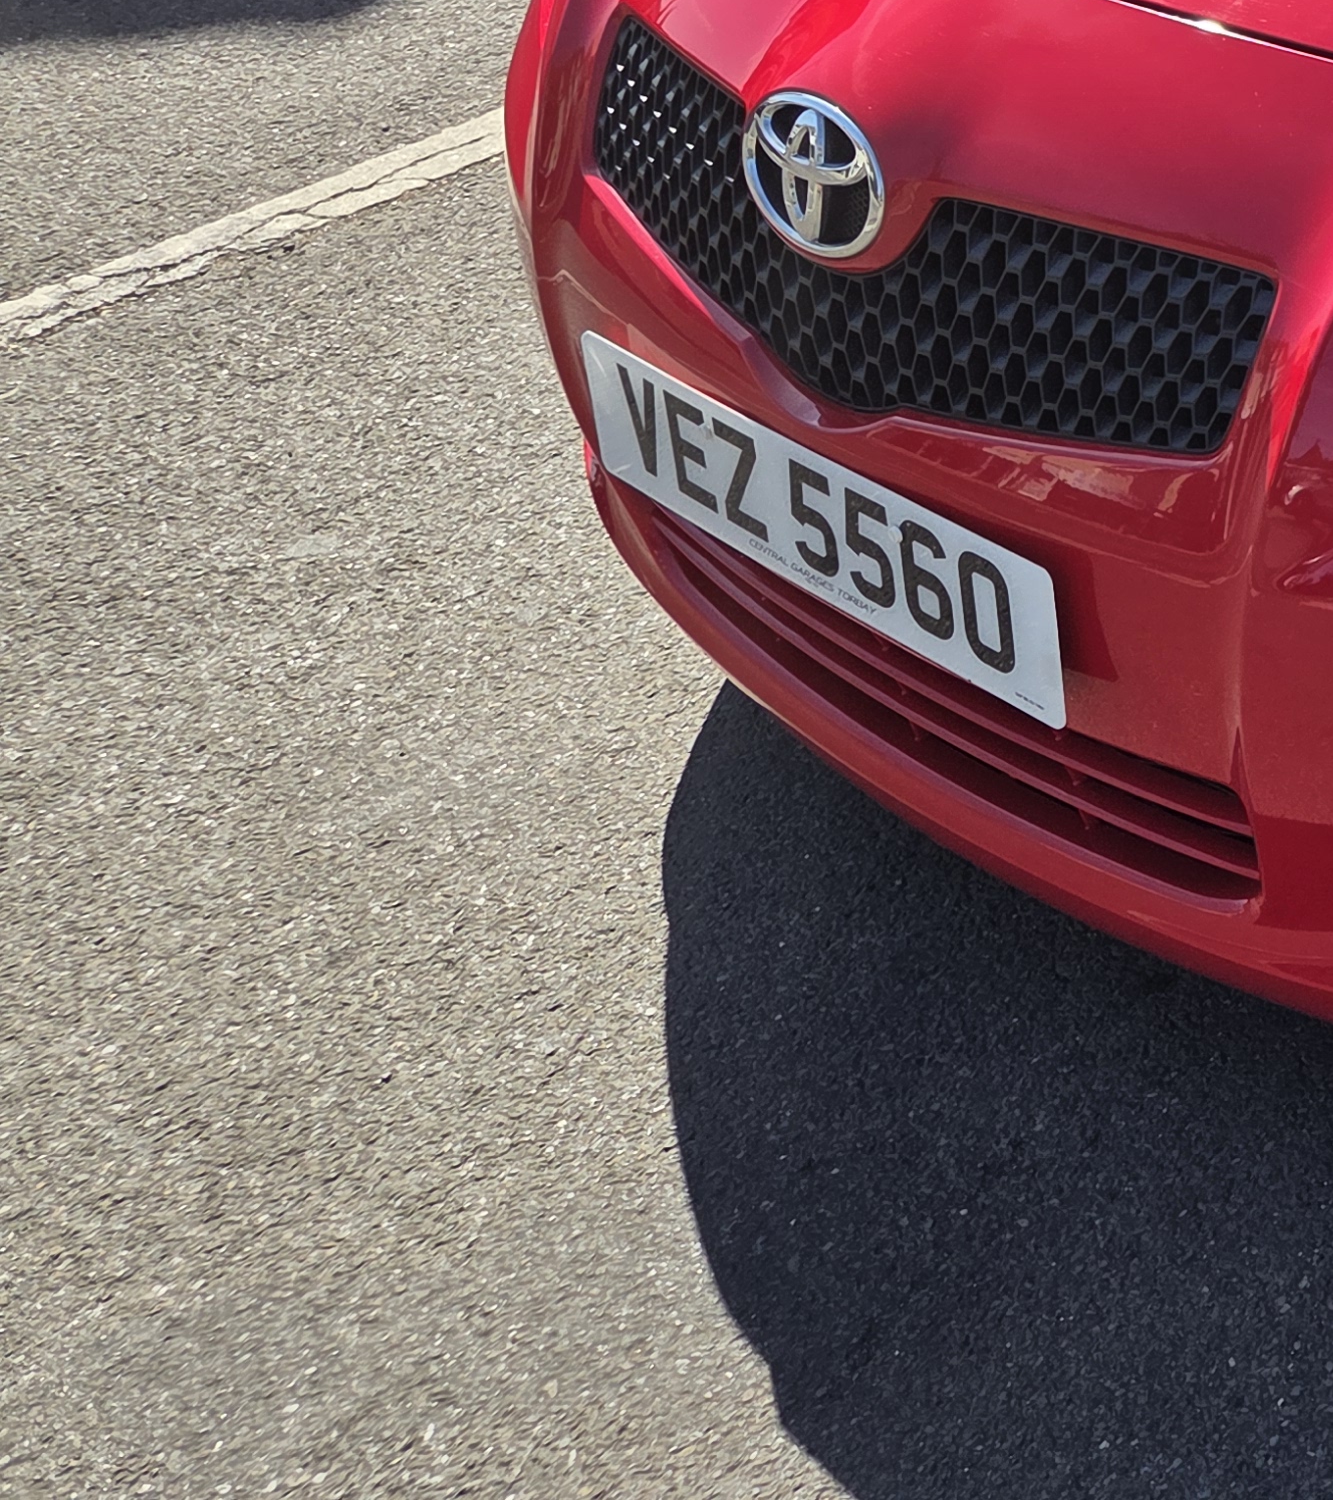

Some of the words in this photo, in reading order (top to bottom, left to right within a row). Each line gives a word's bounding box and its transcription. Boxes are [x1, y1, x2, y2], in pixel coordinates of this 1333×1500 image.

[616, 363, 769, 543] VEZ
[788, 458, 1015, 674] 5560
[749, 538, 788, 566] CENTRAL
[790, 562, 834, 592] GARAGES
[837, 588, 877, 614] TORBAY
